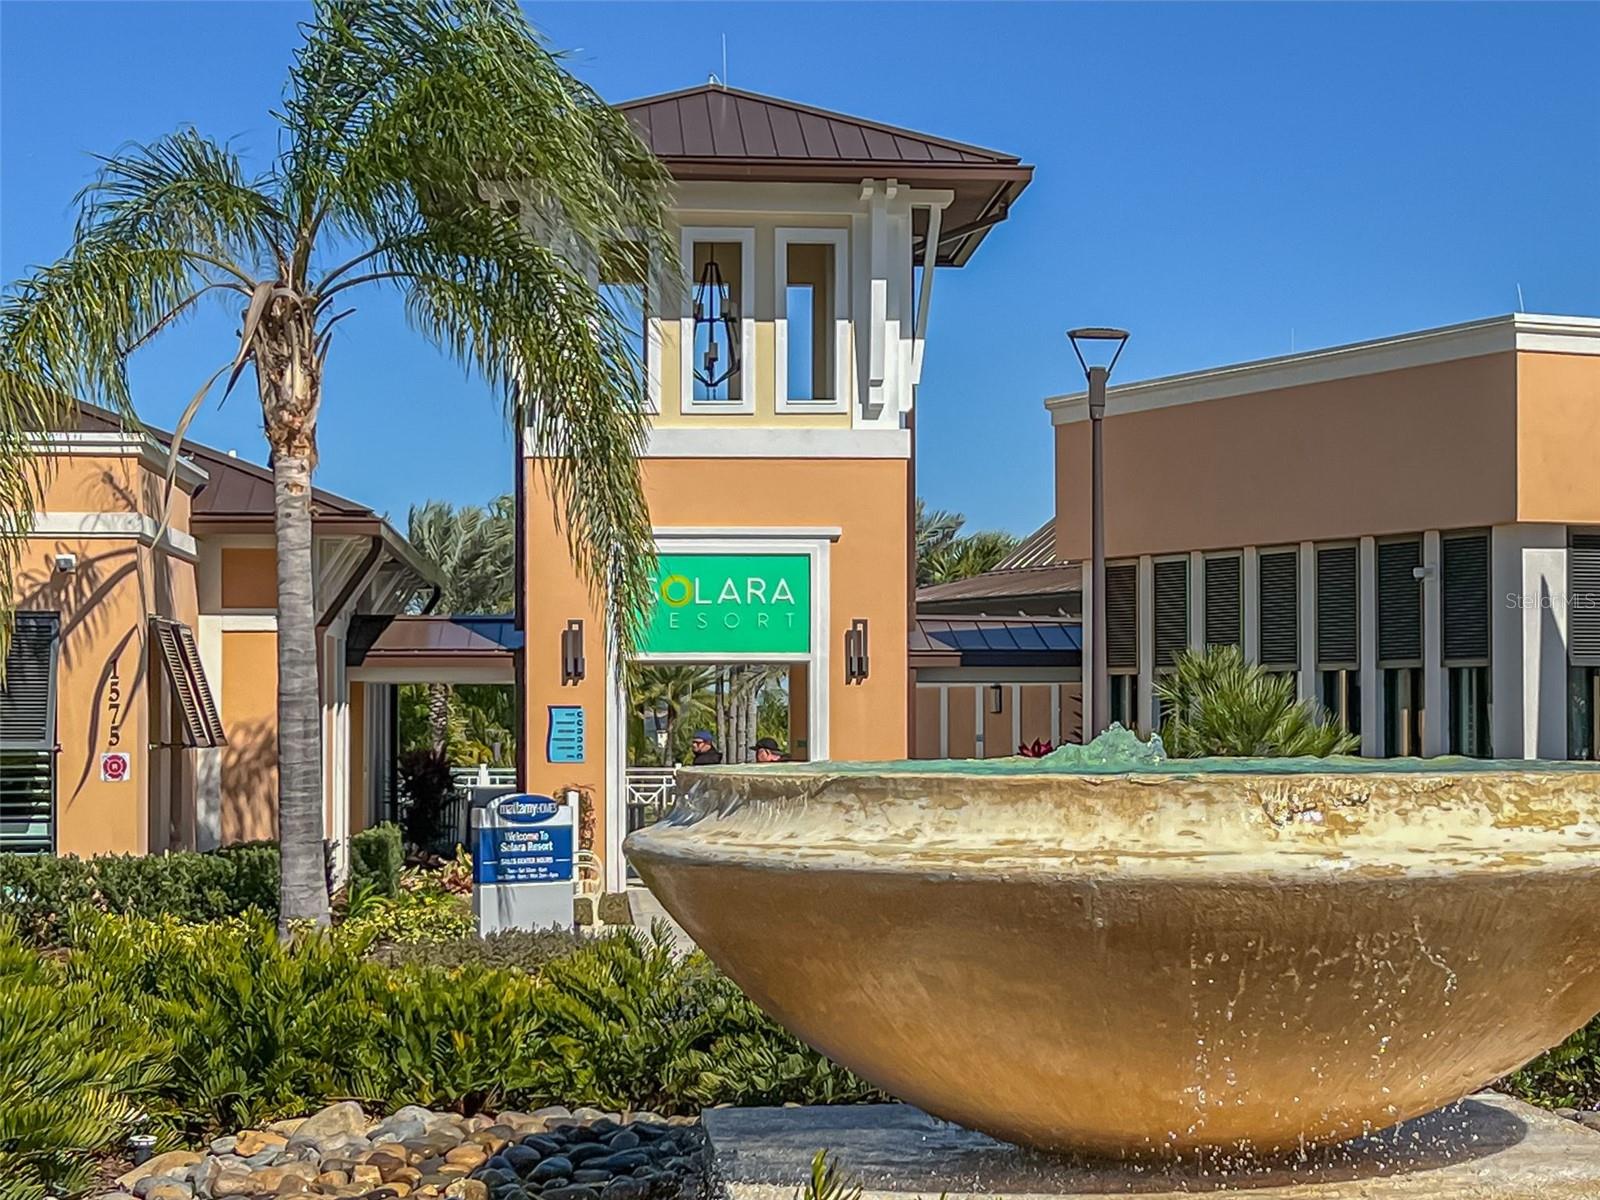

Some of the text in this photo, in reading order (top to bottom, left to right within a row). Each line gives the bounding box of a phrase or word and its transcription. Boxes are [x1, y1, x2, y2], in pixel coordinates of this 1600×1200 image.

[649, 612, 795, 629] ESORT
[108, 659, 120, 746] 1575
[505, 831, 549, 841] Welcome To
[500, 841, 553, 852] Solara Resort
